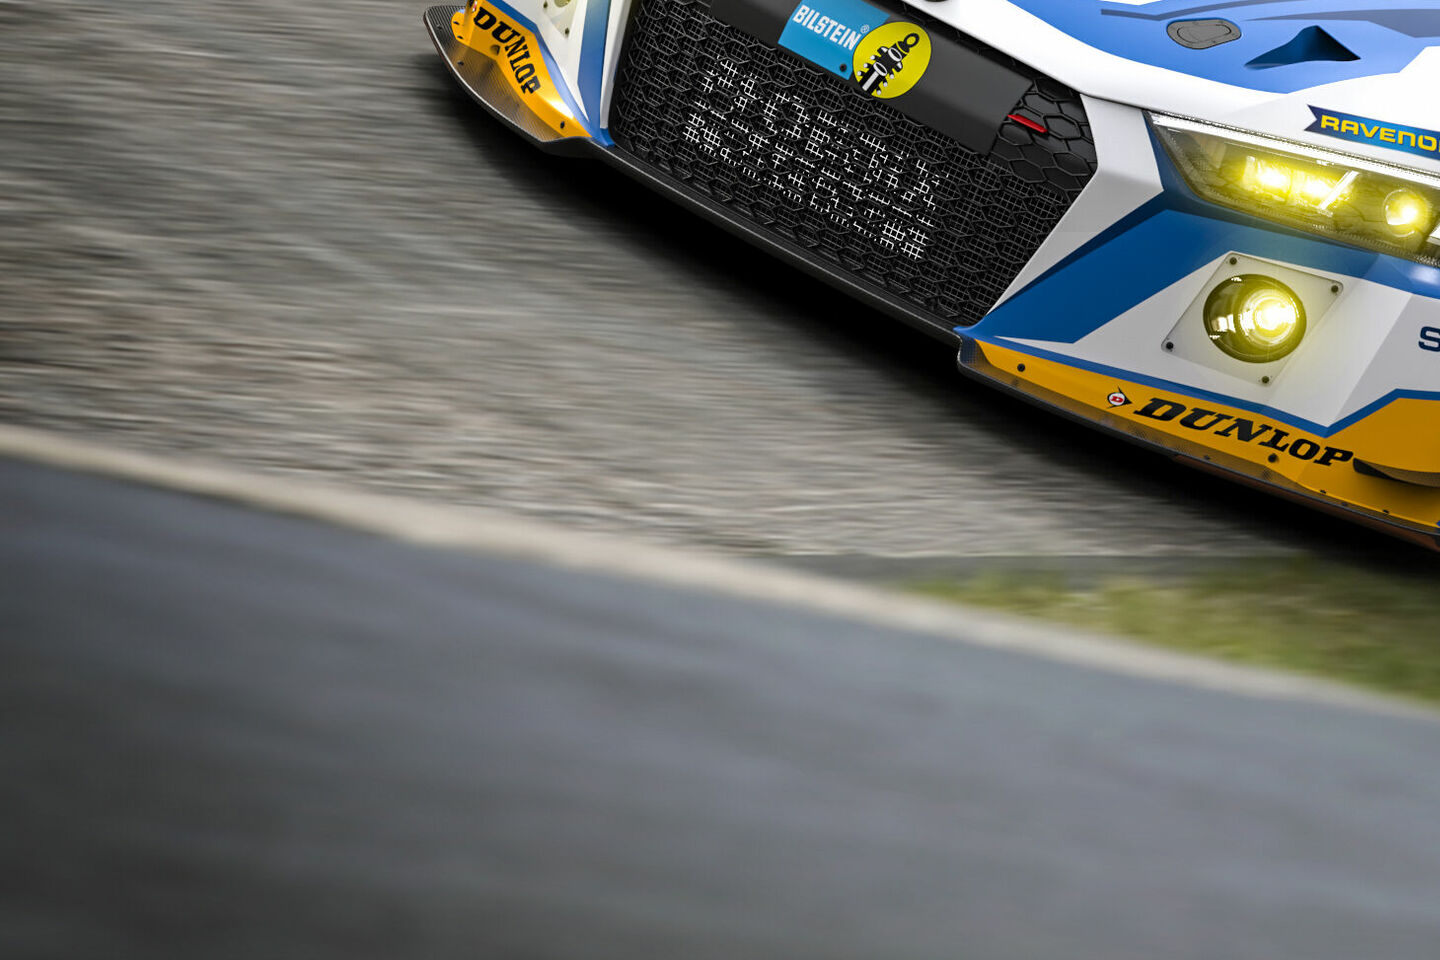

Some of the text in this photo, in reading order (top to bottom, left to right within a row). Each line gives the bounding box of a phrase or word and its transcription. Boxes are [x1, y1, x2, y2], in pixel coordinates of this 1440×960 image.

[473, 6, 541, 94] DUNLOP
[792, 5, 861, 50] BILSTEIN
[1133, 397, 1354, 466] DUNLOP
